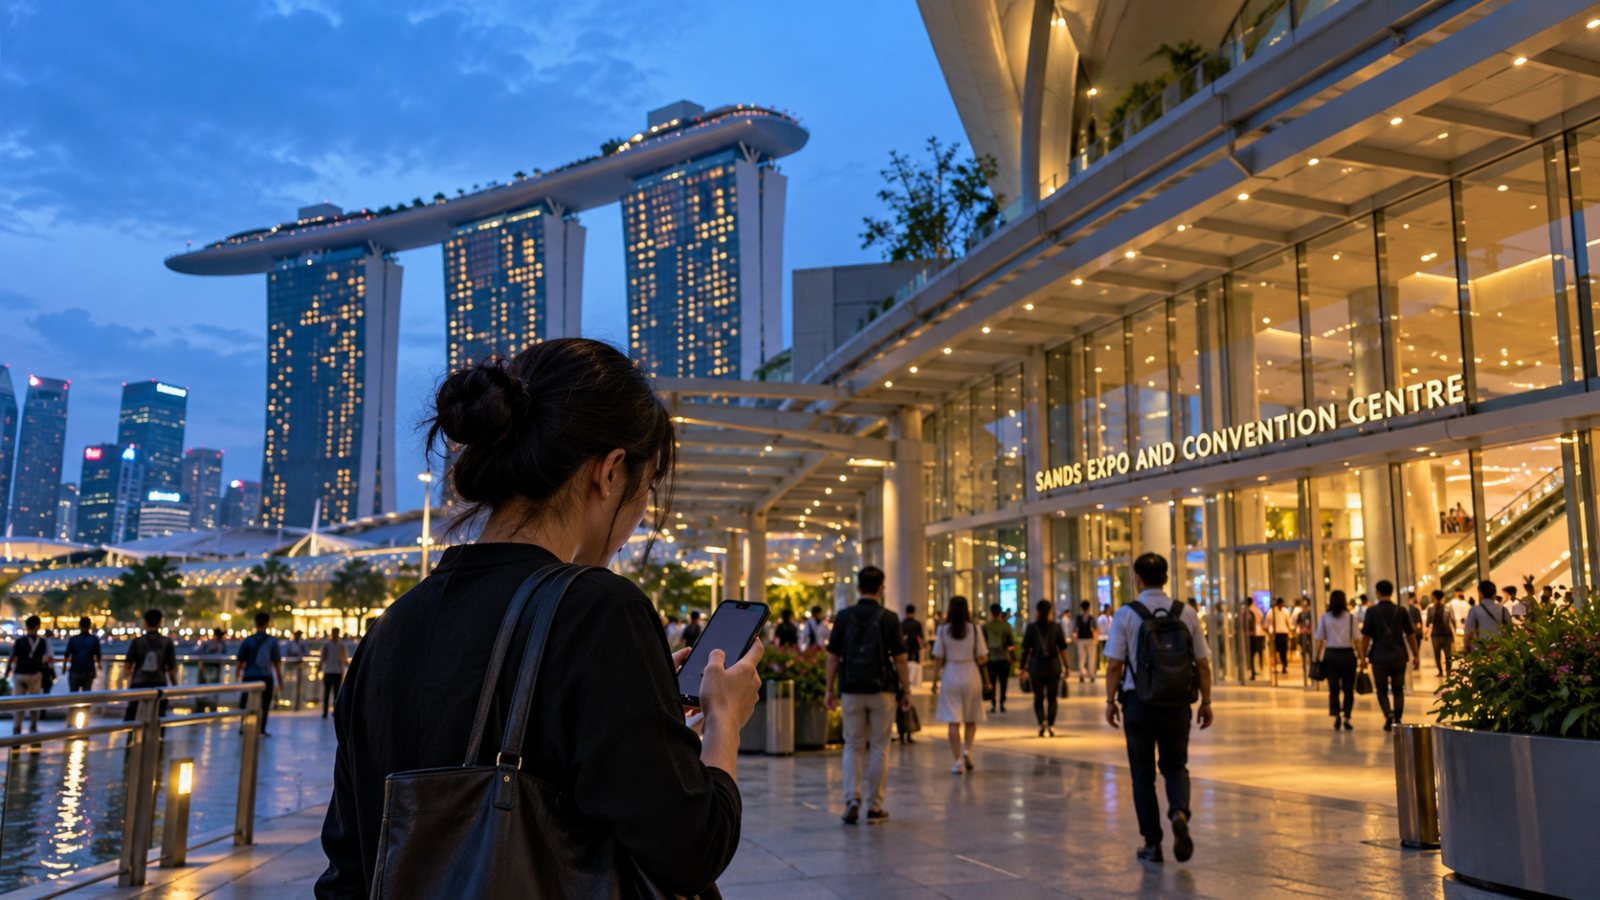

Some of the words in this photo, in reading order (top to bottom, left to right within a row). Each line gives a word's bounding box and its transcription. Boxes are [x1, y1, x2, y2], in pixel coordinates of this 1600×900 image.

[1035, 462, 1082, 492] SANDS
[1087, 452, 1130, 481] EXPO
[1135, 441, 1175, 471] AND
[1182, 403, 1337, 460] CONVENTION
[1348, 373, 1465, 425] CENTRE
